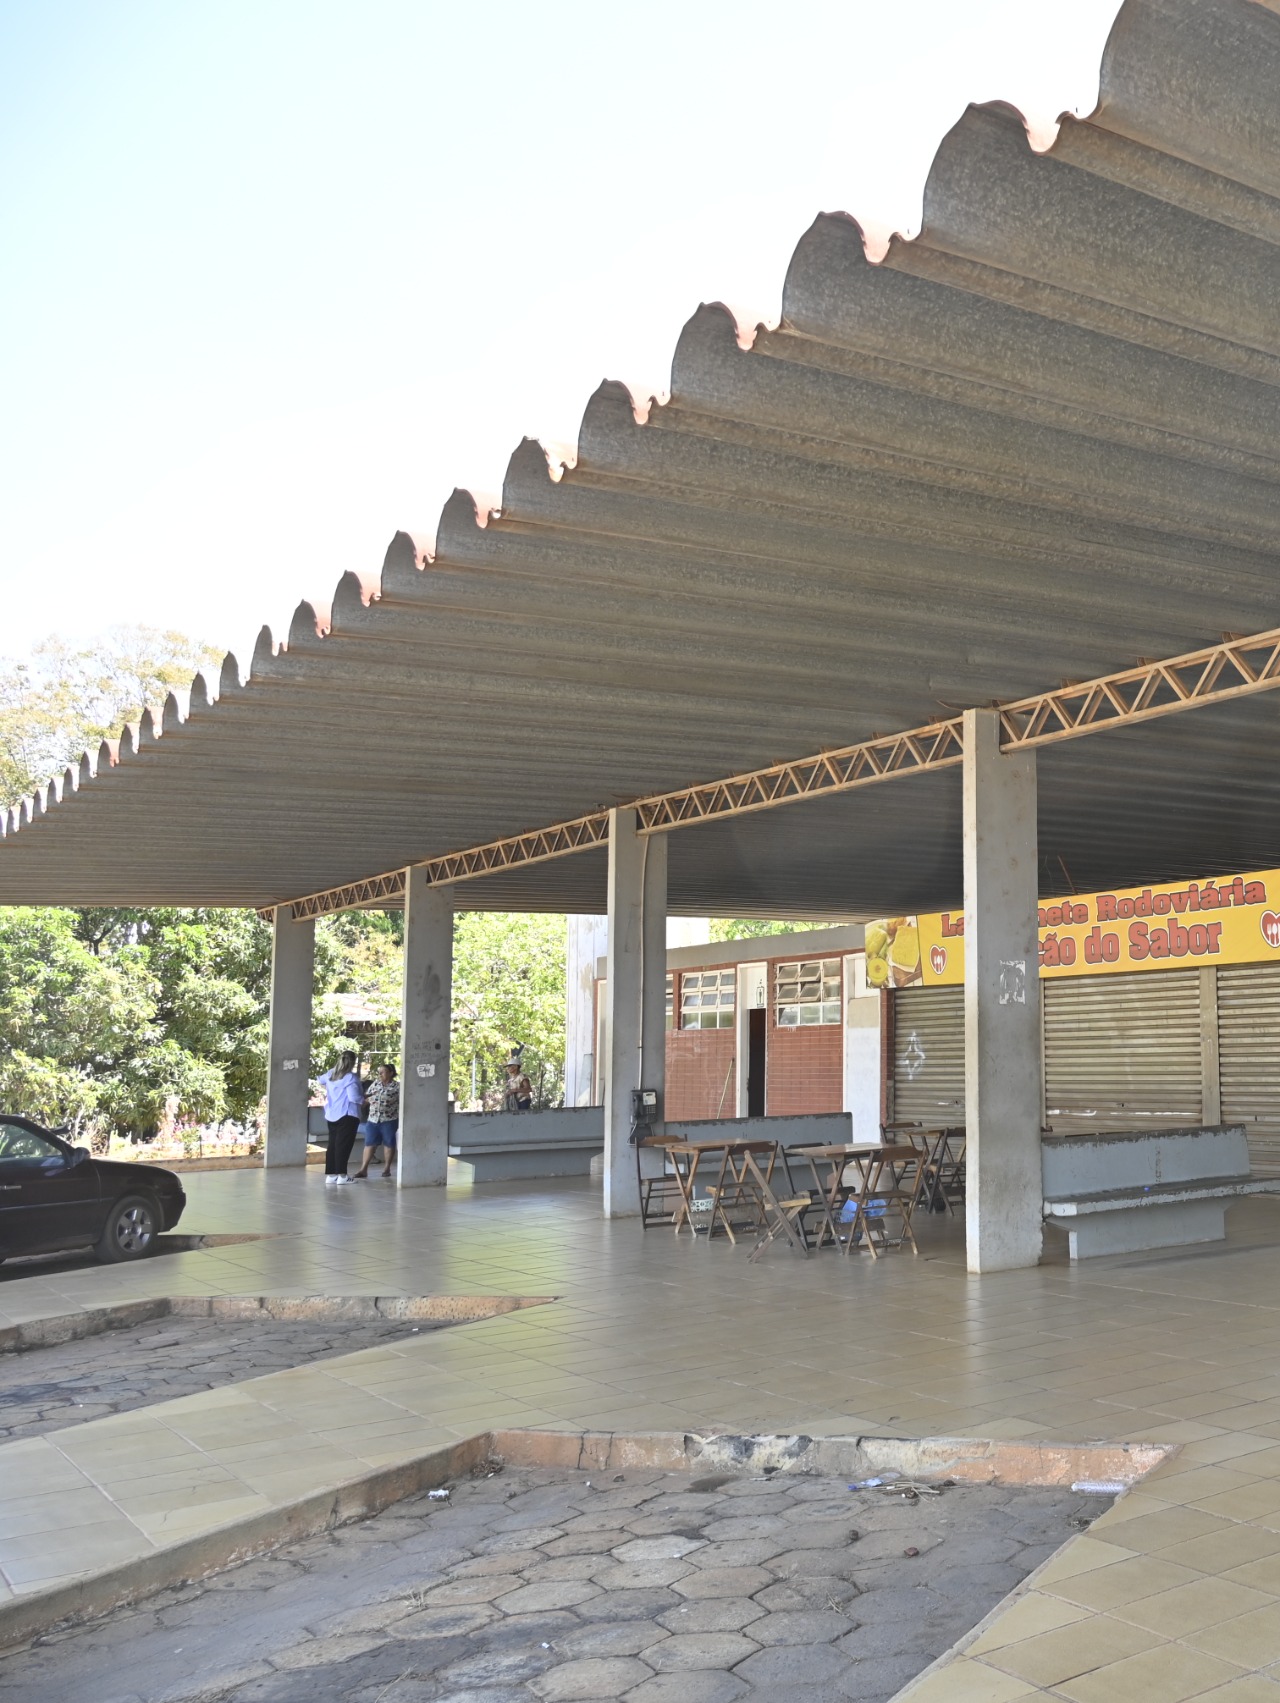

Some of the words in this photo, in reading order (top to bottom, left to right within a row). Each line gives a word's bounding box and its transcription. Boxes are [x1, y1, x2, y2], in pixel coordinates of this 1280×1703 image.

[1096, 877, 1266, 921] Rodoviária
[1084, 926, 1120, 964] do
[1128, 917, 1222, 961] Sabor
